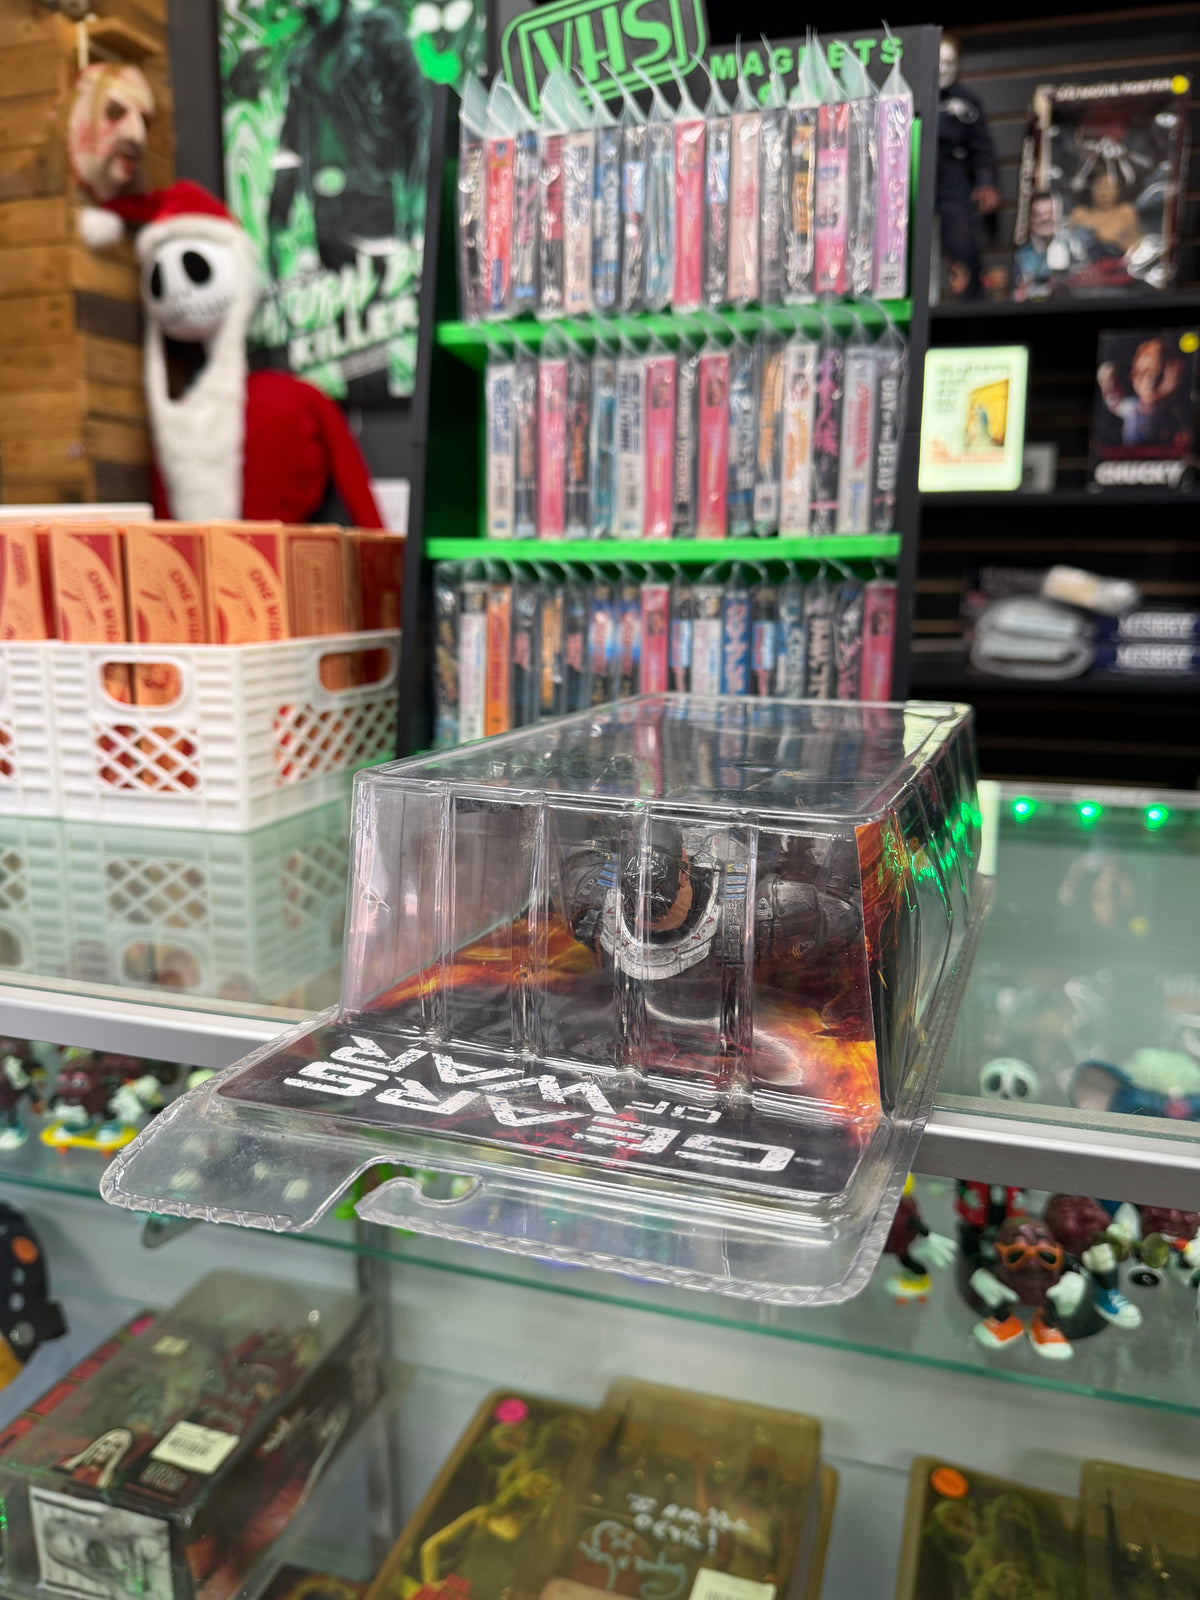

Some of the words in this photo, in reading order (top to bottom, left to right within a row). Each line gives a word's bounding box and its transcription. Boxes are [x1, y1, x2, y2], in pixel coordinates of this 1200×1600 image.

[531, 0, 673, 82] VHS
[881, 378, 898, 411] DAY
[877, 442, 897, 491] DEAD
[86, 569, 111, 602] ONE
[170, 569, 195, 602] ONE
[249, 568, 275, 600] ONE
[330, 1035, 617, 1115] WAR
[283, 1061, 796, 1172] GEARS
[624, 1100, 722, 1124] OF
